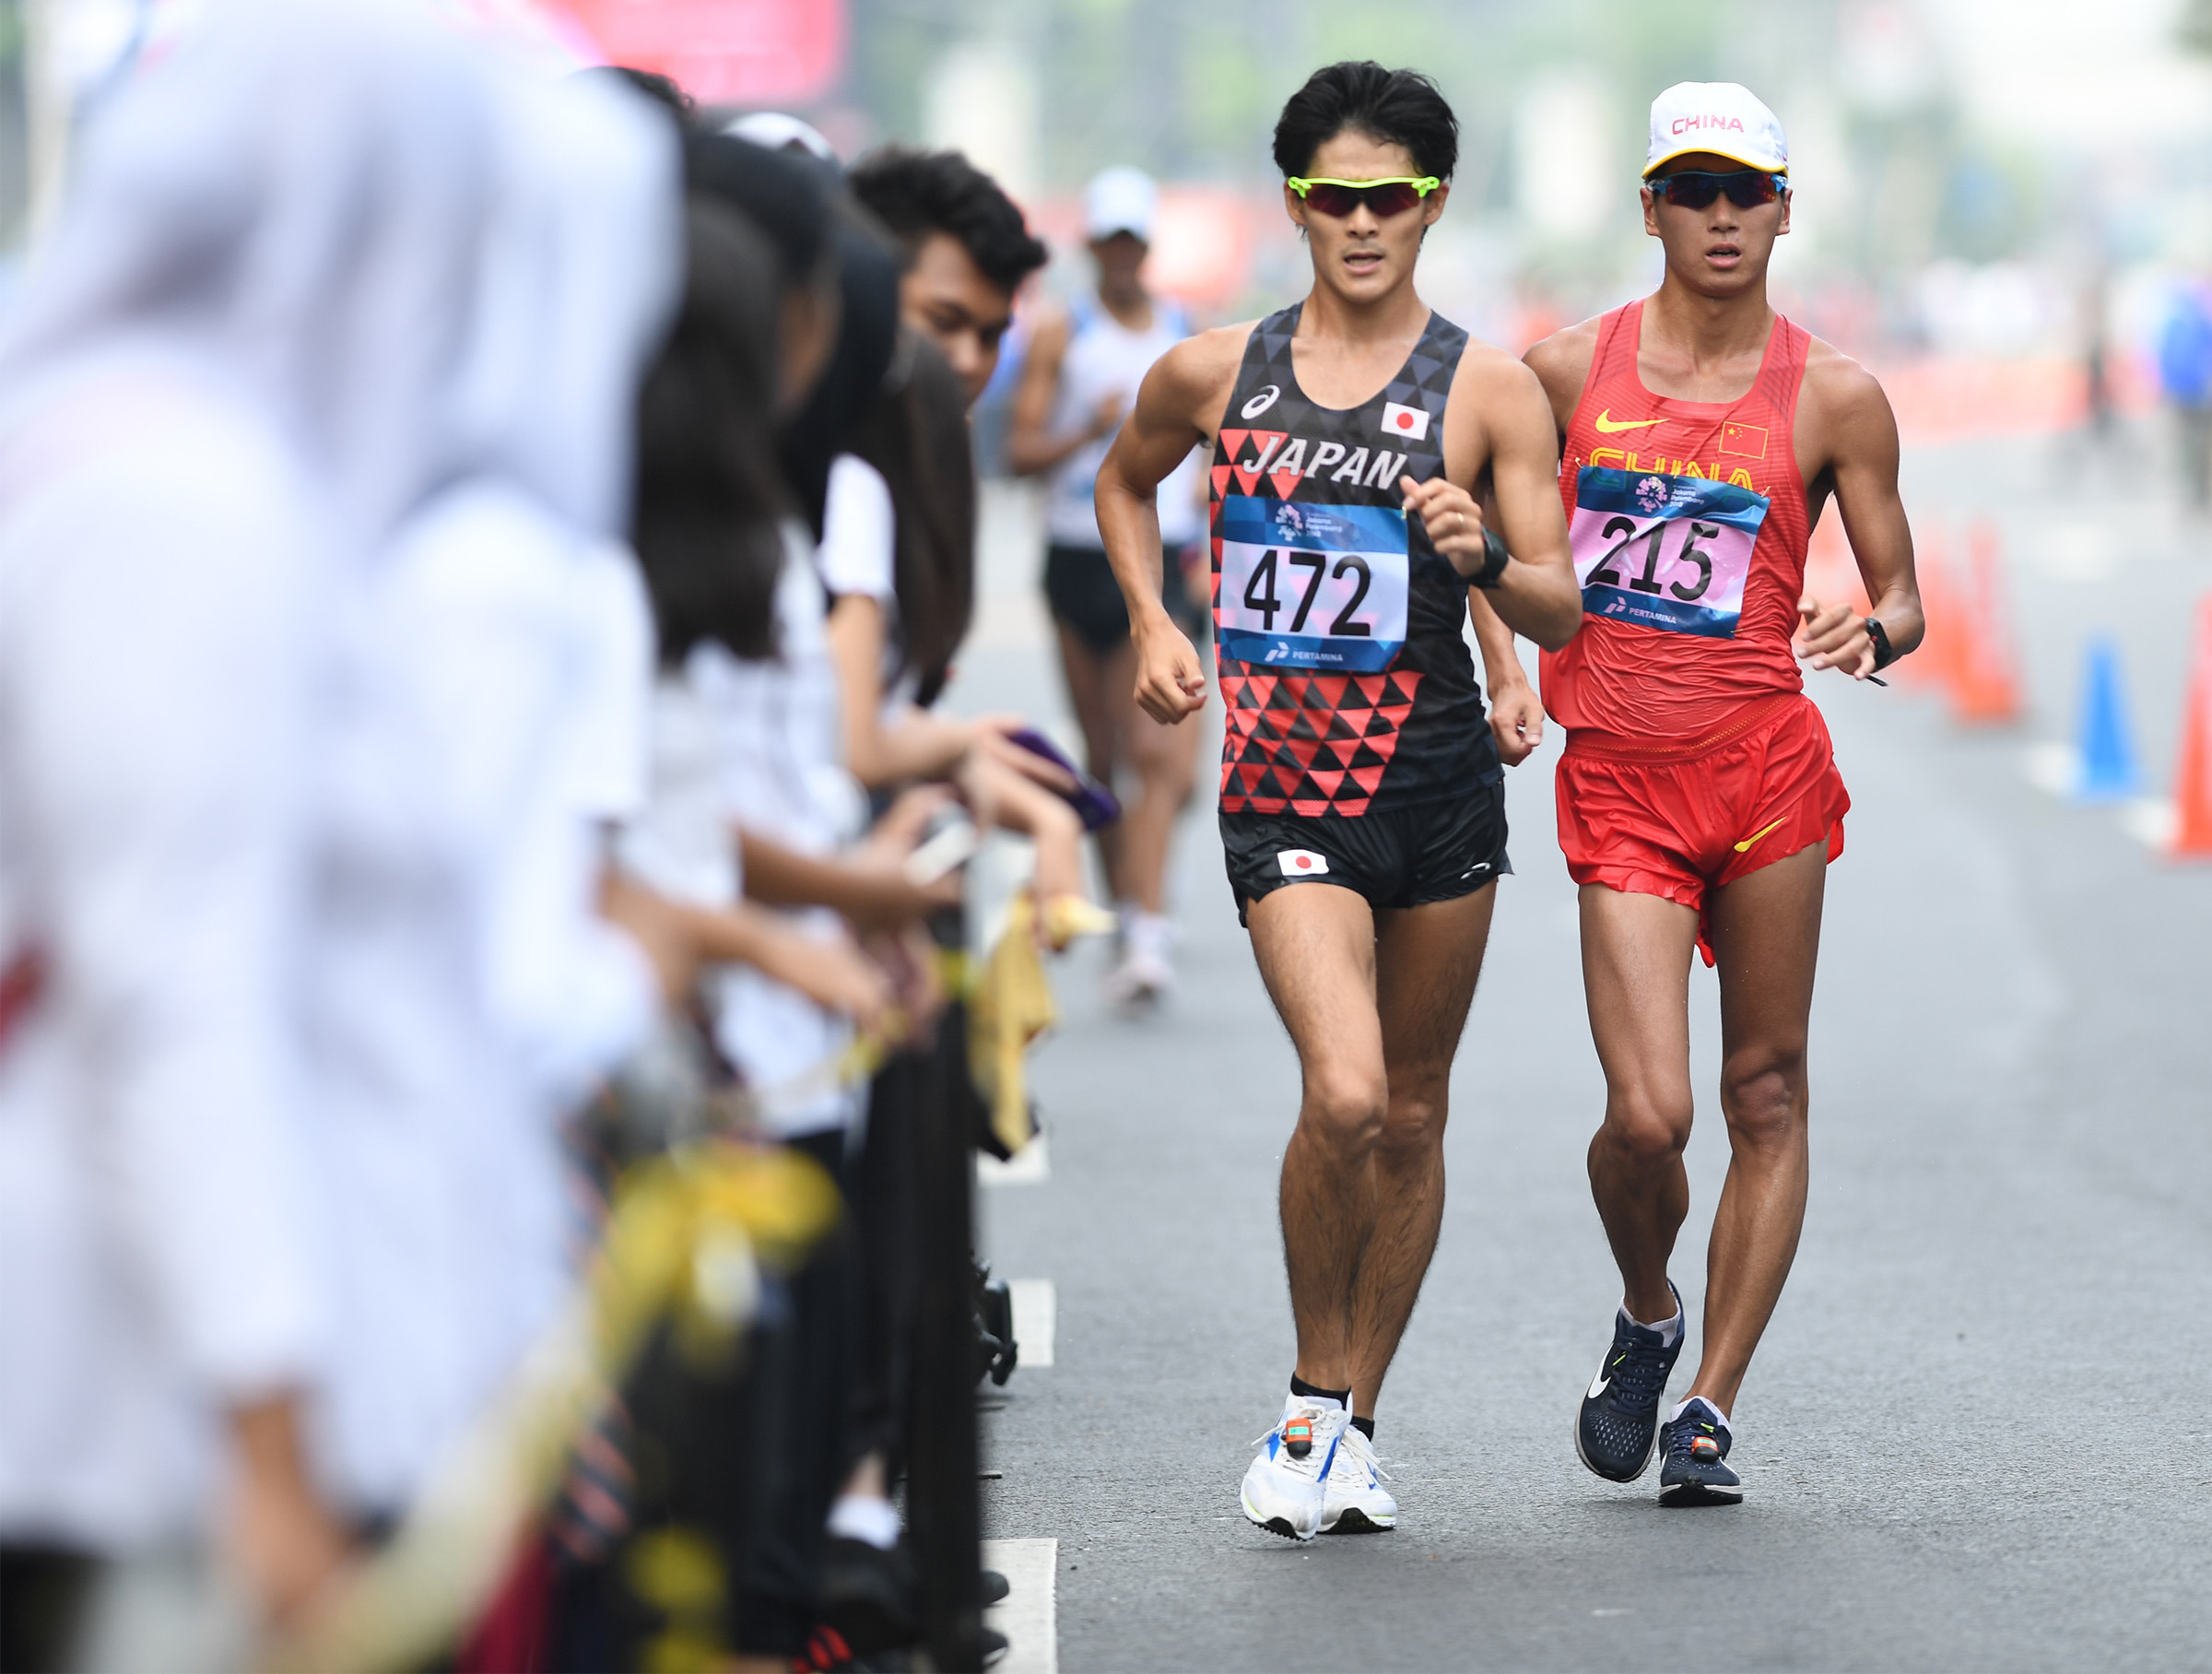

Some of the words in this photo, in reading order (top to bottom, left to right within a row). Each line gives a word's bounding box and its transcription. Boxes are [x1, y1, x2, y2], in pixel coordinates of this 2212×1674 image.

[1672, 114, 1744, 135] CHINA
[1242, 435, 1408, 490] JAPAN
[1585, 516, 1720, 601] 215
[1243, 549, 1371, 636] 472
[1629, 607, 1677, 624] PERTAMINA
[1292, 650, 1343, 662] PERTAMINA
